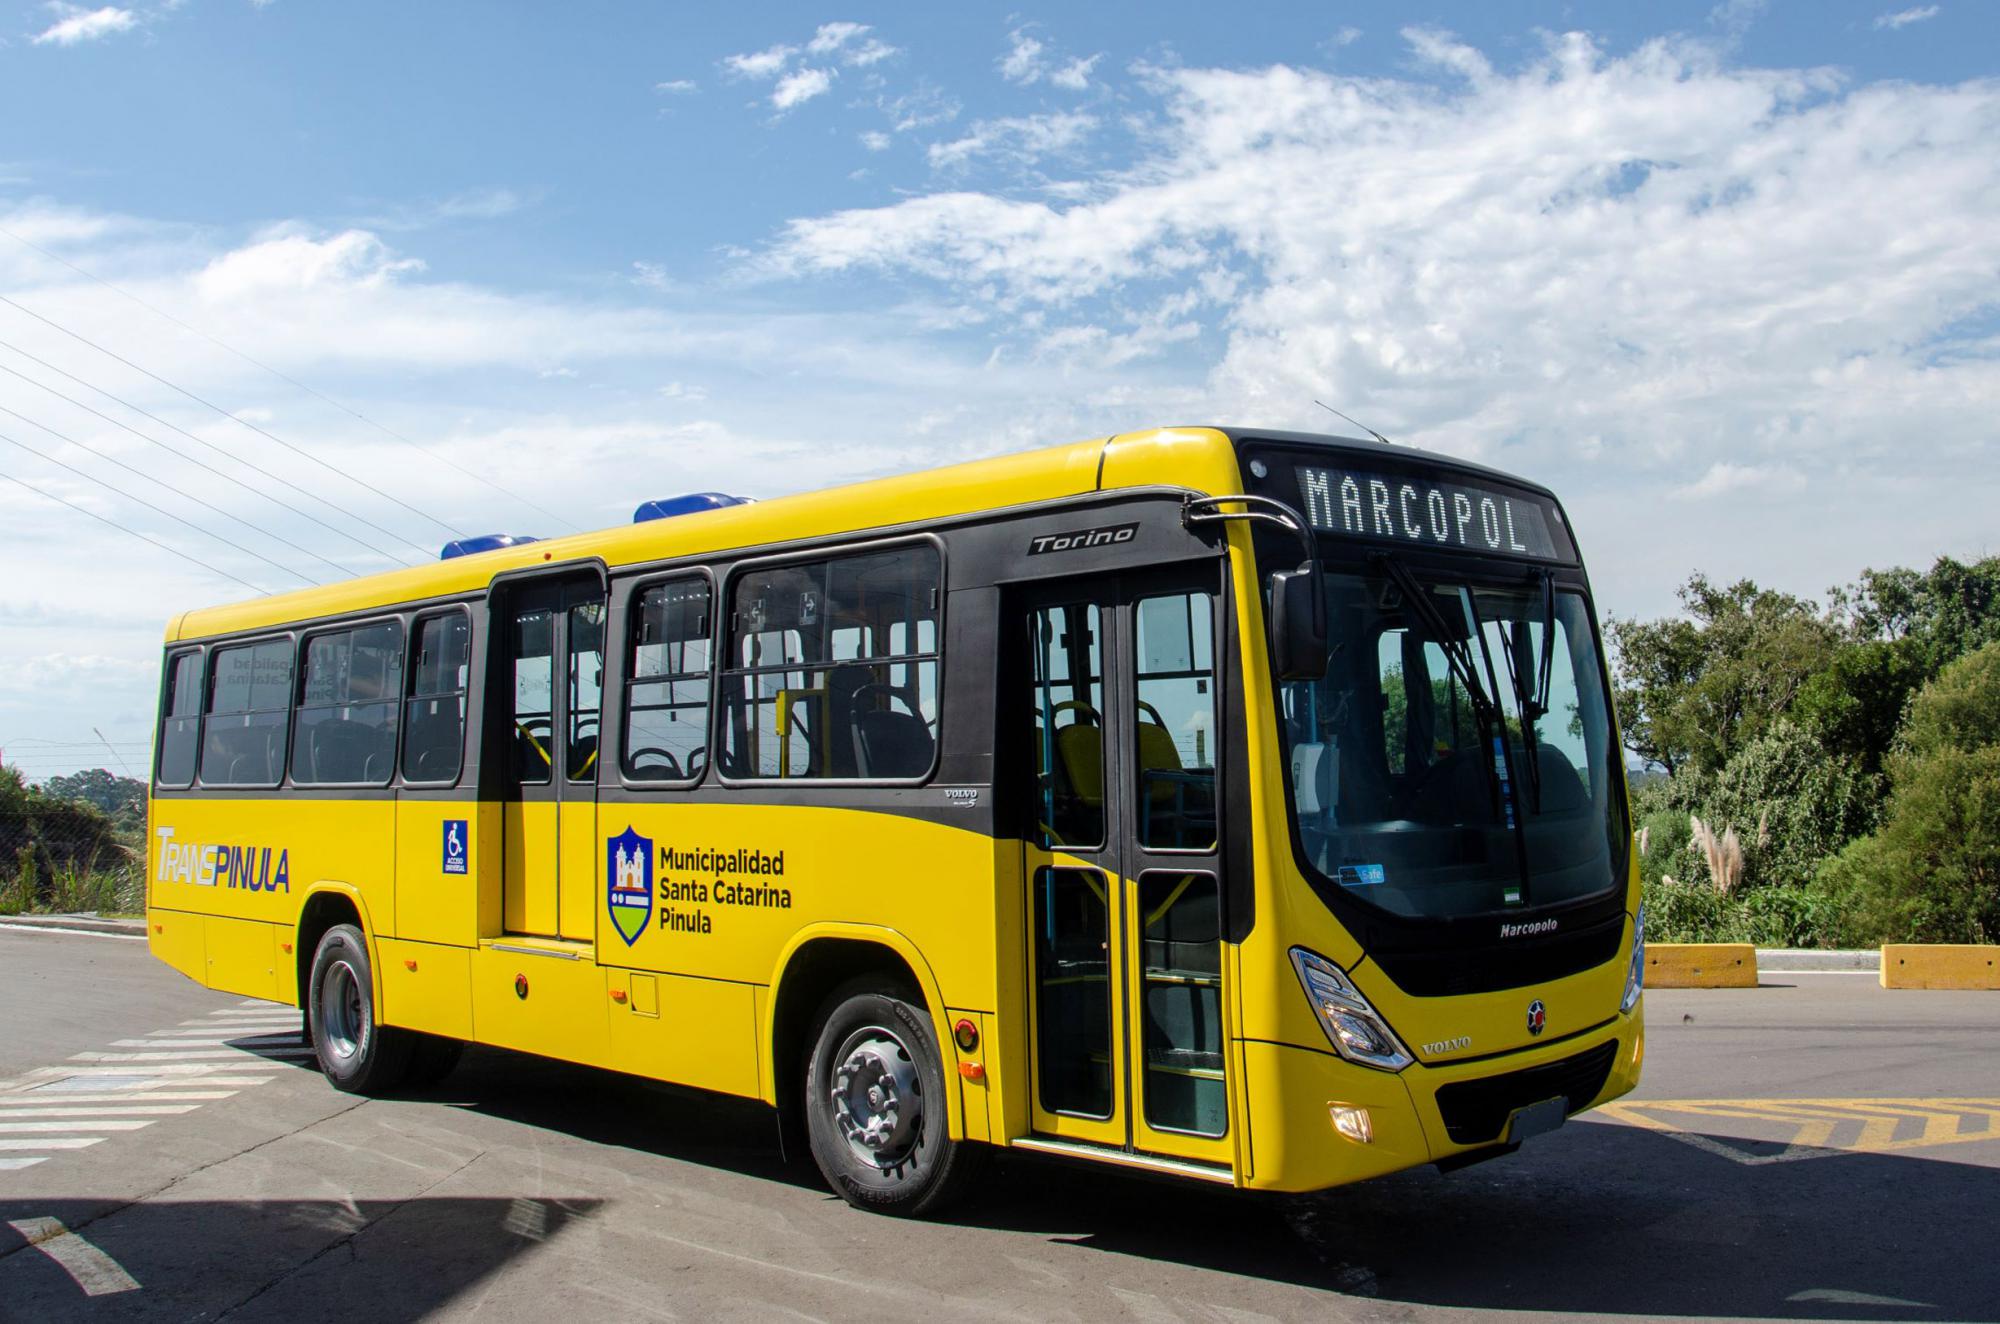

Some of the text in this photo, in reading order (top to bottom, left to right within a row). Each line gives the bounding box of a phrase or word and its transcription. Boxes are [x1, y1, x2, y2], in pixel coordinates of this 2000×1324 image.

[1306, 470, 1526, 551] MARCOPOL
[1033, 528, 1133, 552] Torino
[944, 789, 978, 799] VOLVO
[660, 847, 784, 877] Municipalidad
[660, 877, 791, 908] Santa Catarina
[660, 907, 711, 934] Pinula
[1500, 918, 1558, 938] Marcopolo
[1422, 1036, 1472, 1056] VOLVO
